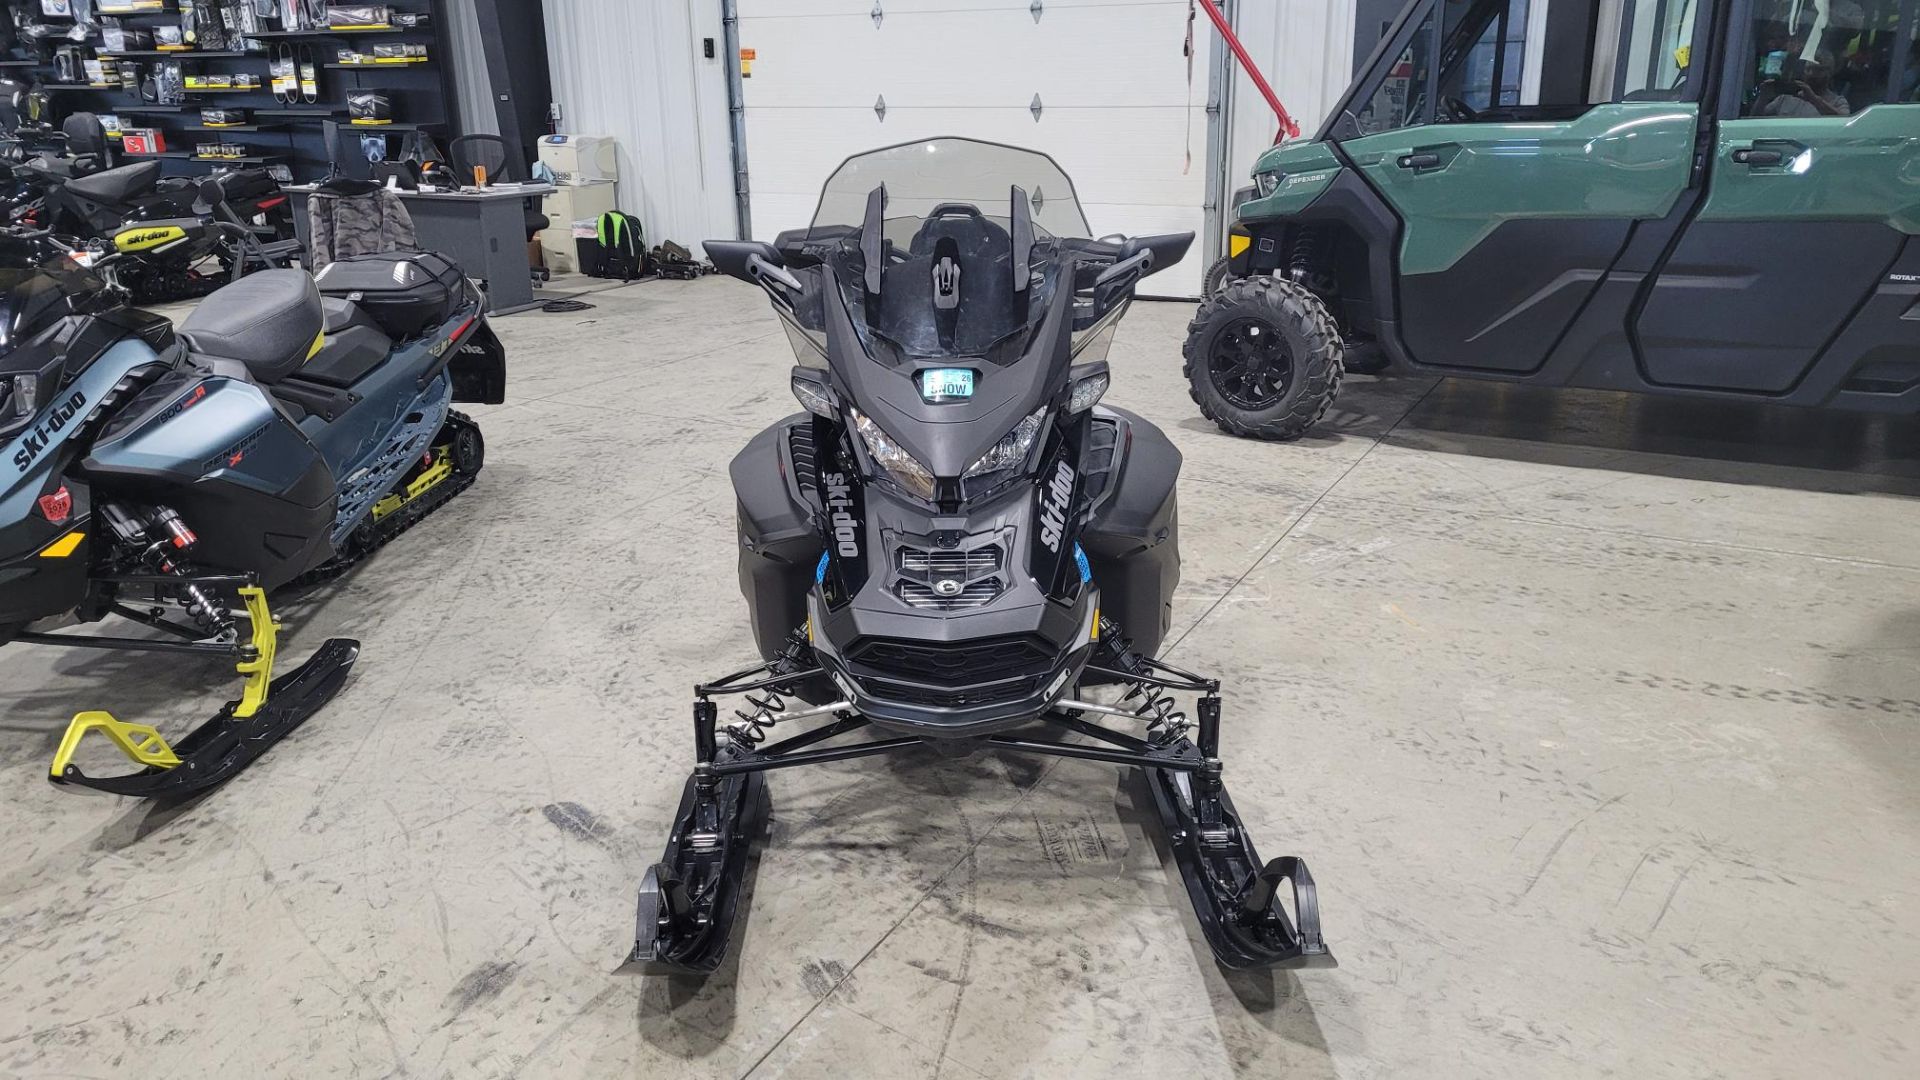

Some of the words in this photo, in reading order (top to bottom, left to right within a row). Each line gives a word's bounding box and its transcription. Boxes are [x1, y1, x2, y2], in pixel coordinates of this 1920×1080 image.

[1289, 175, 1326, 184] DEFENDER
[127, 231, 169, 244] ski-doo
[1890, 273, 1916, 281] ROTAX
[961, 374, 972, 383] 26
[13, 391, 87, 472] ski-doo
[1040, 460, 1075, 553] ski-doo
[826, 472, 858, 557] ski-doo
